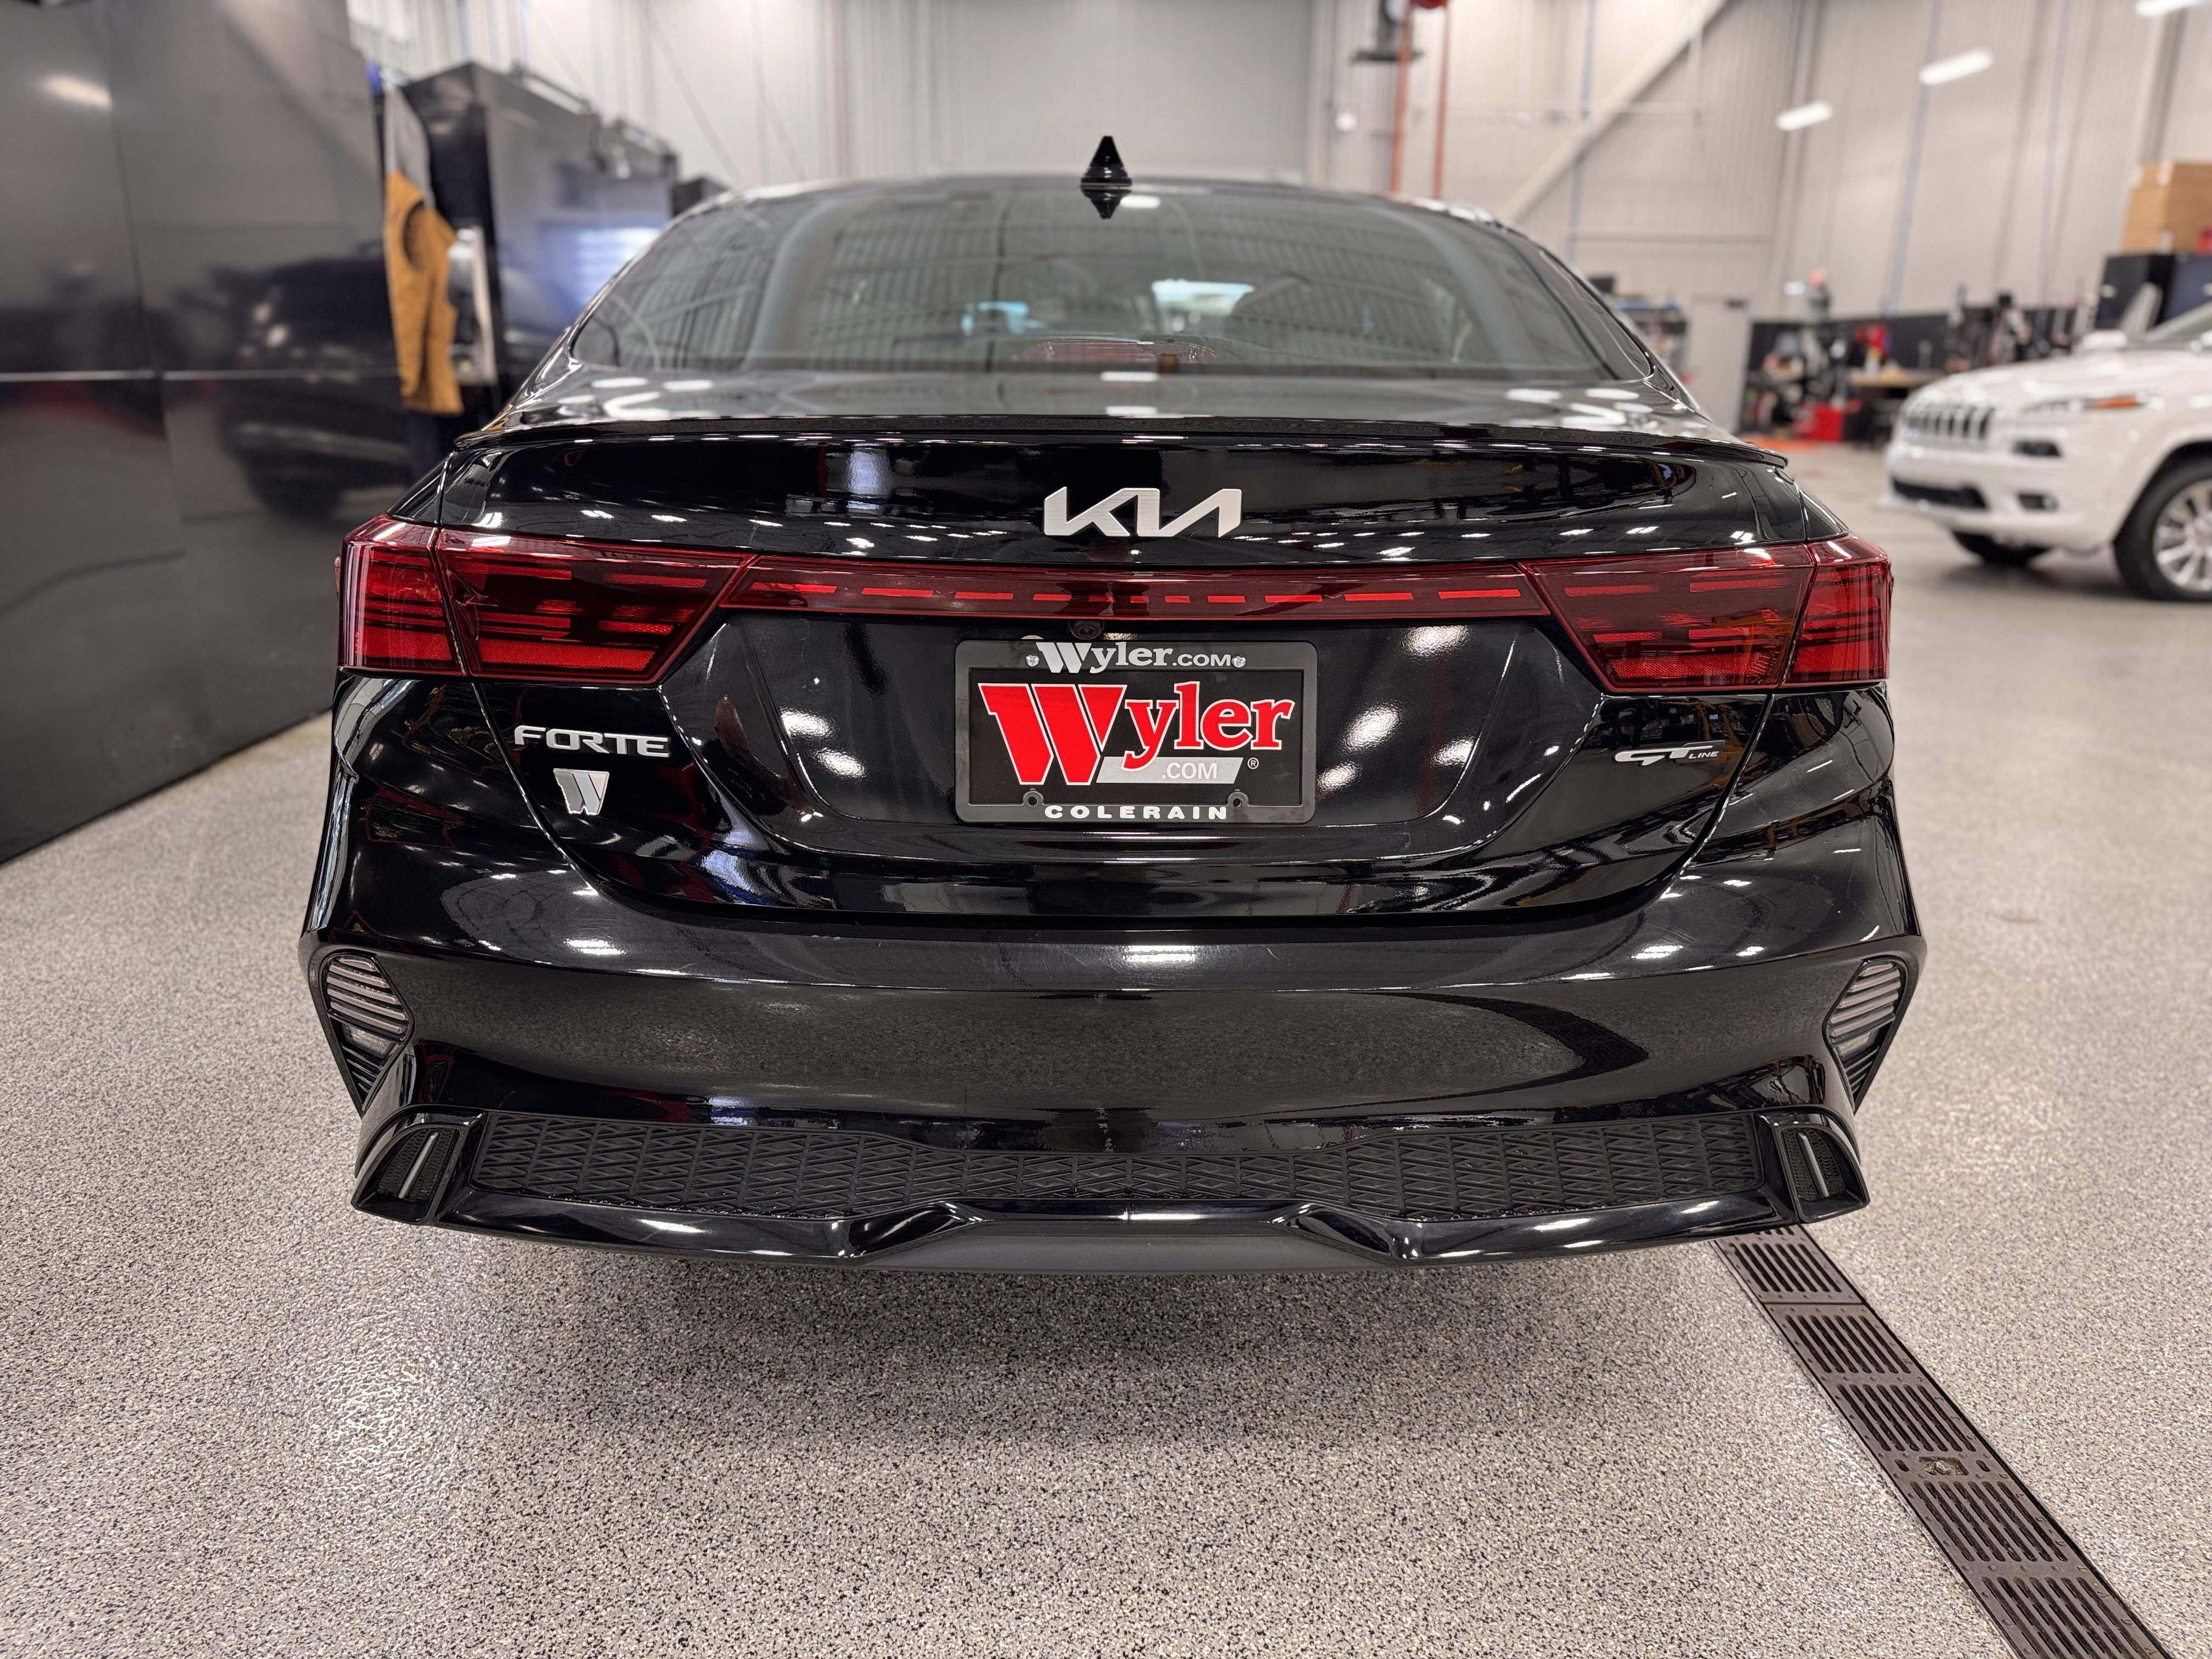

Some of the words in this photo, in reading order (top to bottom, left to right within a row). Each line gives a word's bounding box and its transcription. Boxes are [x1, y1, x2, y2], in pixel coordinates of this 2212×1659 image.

[1044, 486, 1242, 538] KIA
[514, 725, 670, 758] FORTE
[977, 680, 1295, 785] Wyler
[1615, 745, 1713, 766] GT
[1688, 751, 1720, 759] LINE
[1045, 805, 1227, 820] COLERAIN
